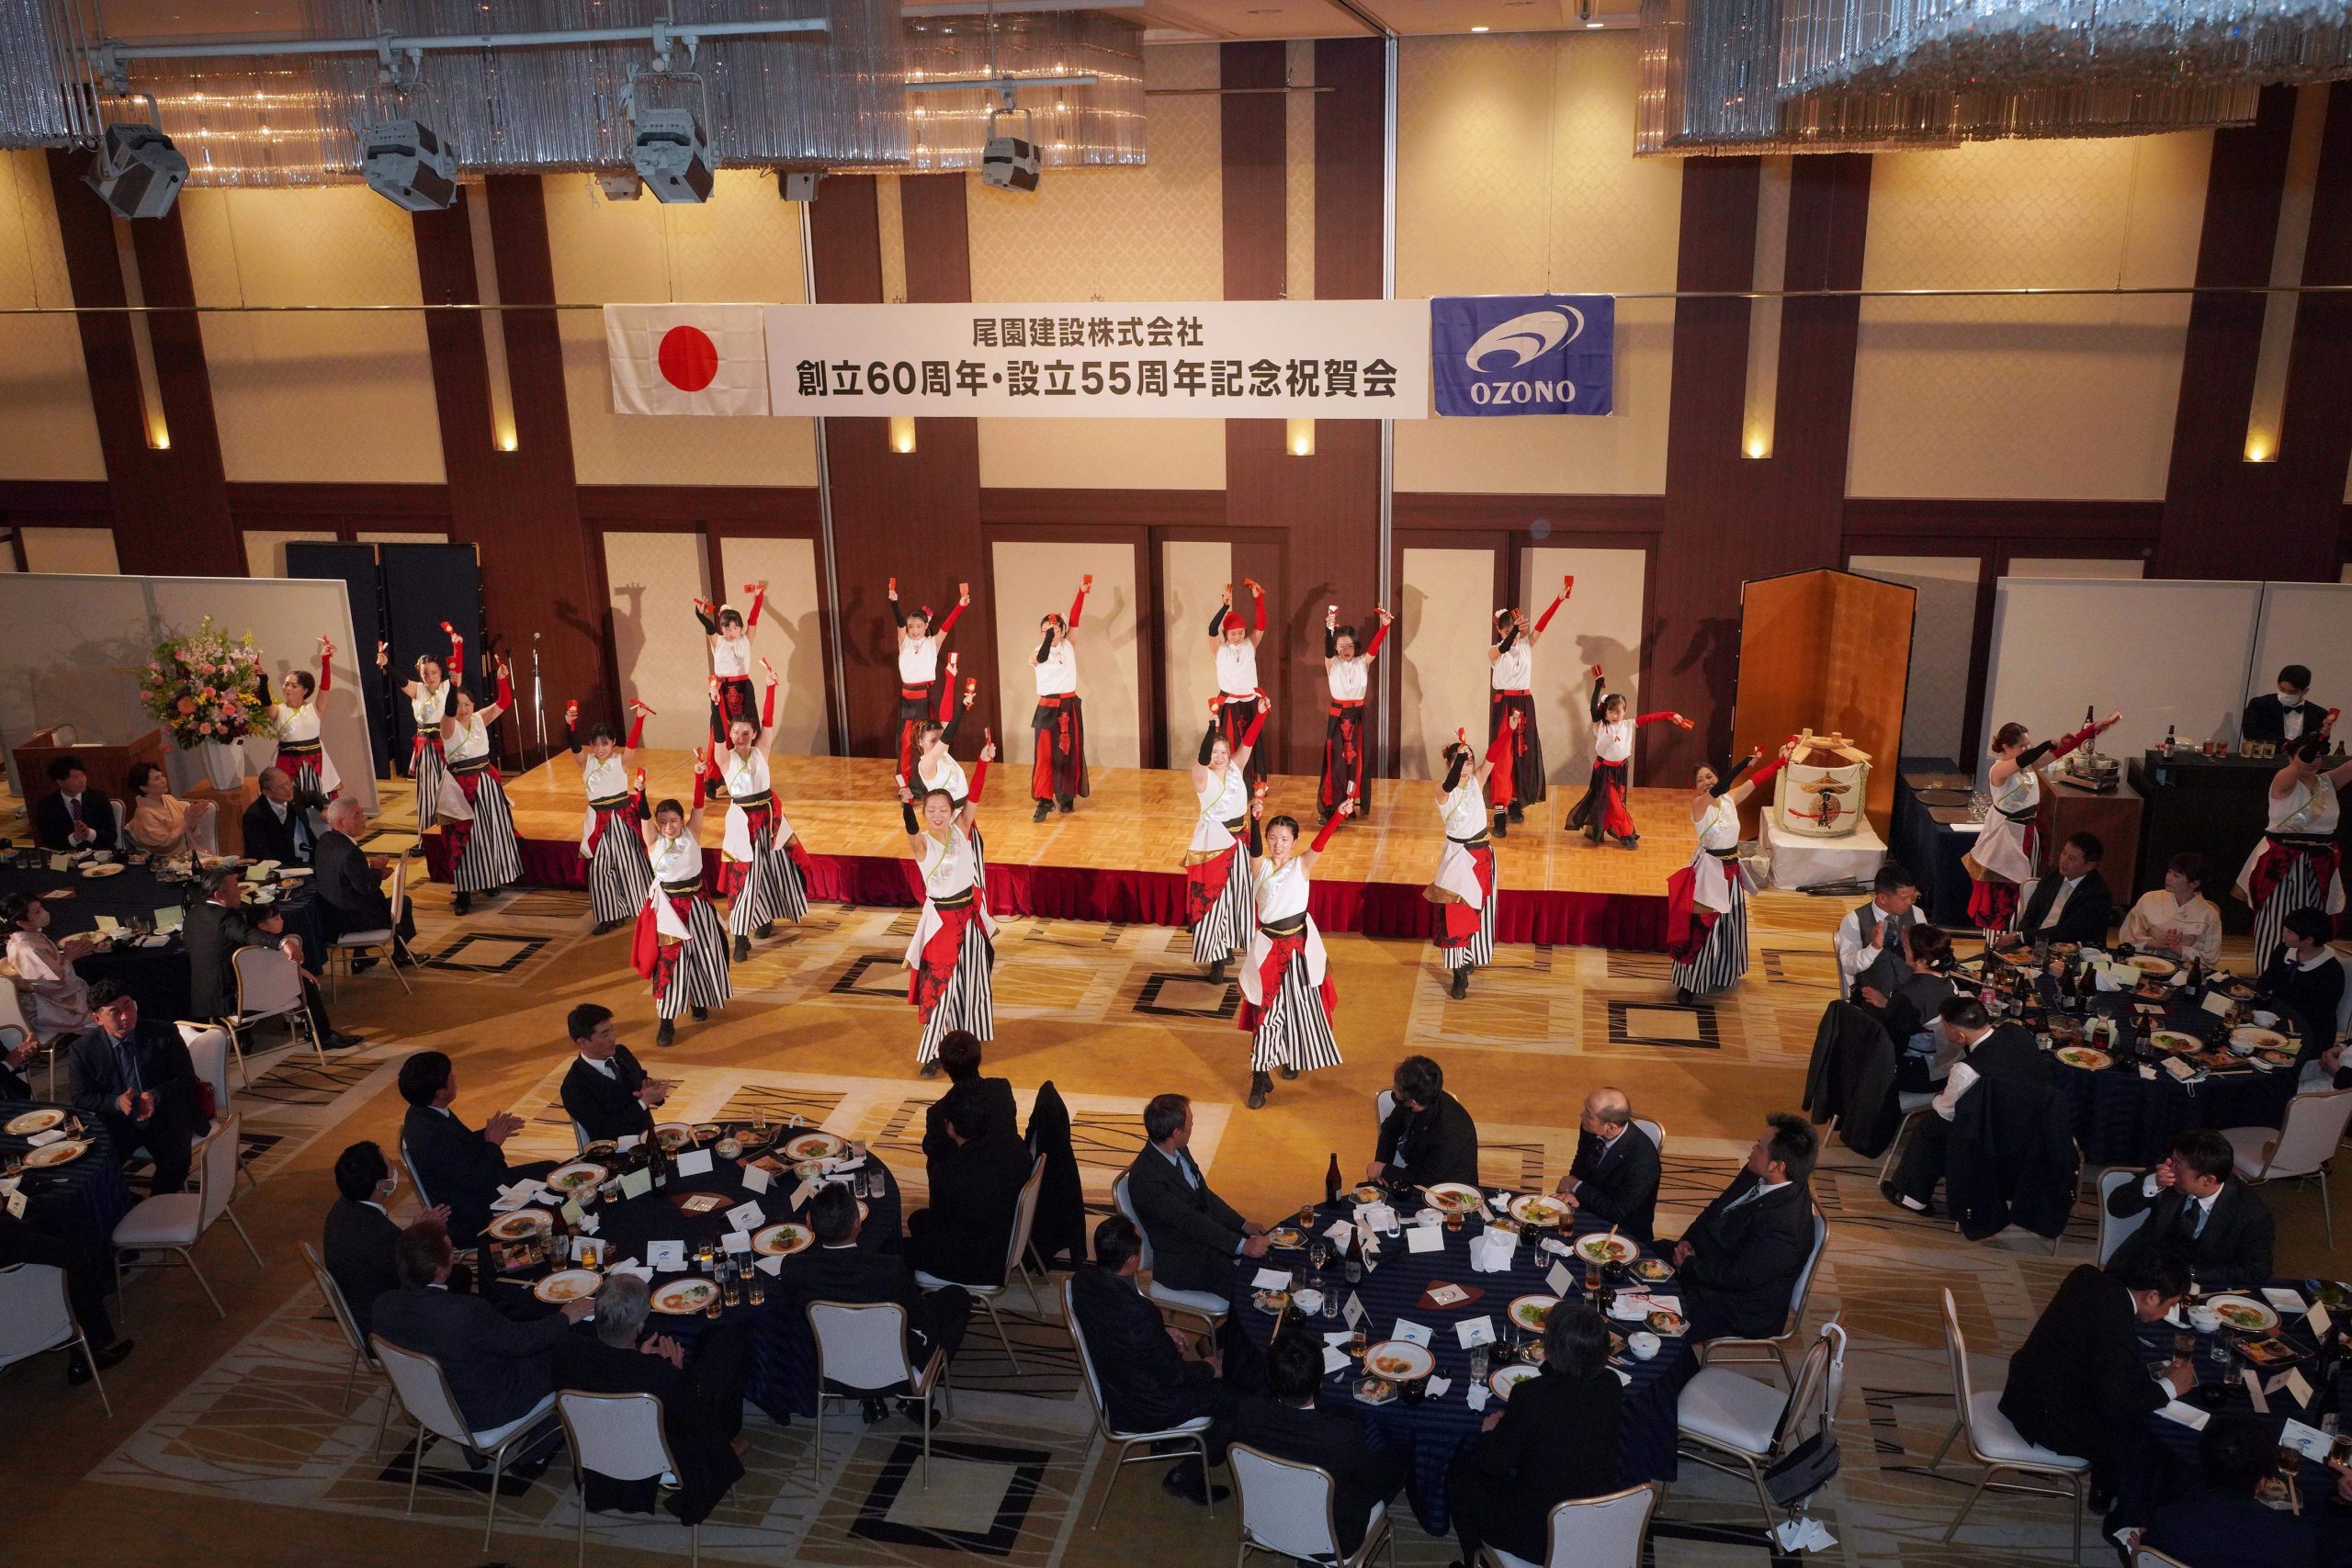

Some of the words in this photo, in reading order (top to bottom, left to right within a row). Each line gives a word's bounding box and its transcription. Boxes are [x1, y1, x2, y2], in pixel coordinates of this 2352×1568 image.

[973, 316, 1204, 347] 尾園建設株式会社
[1471, 380, 1577, 405] OZONO
